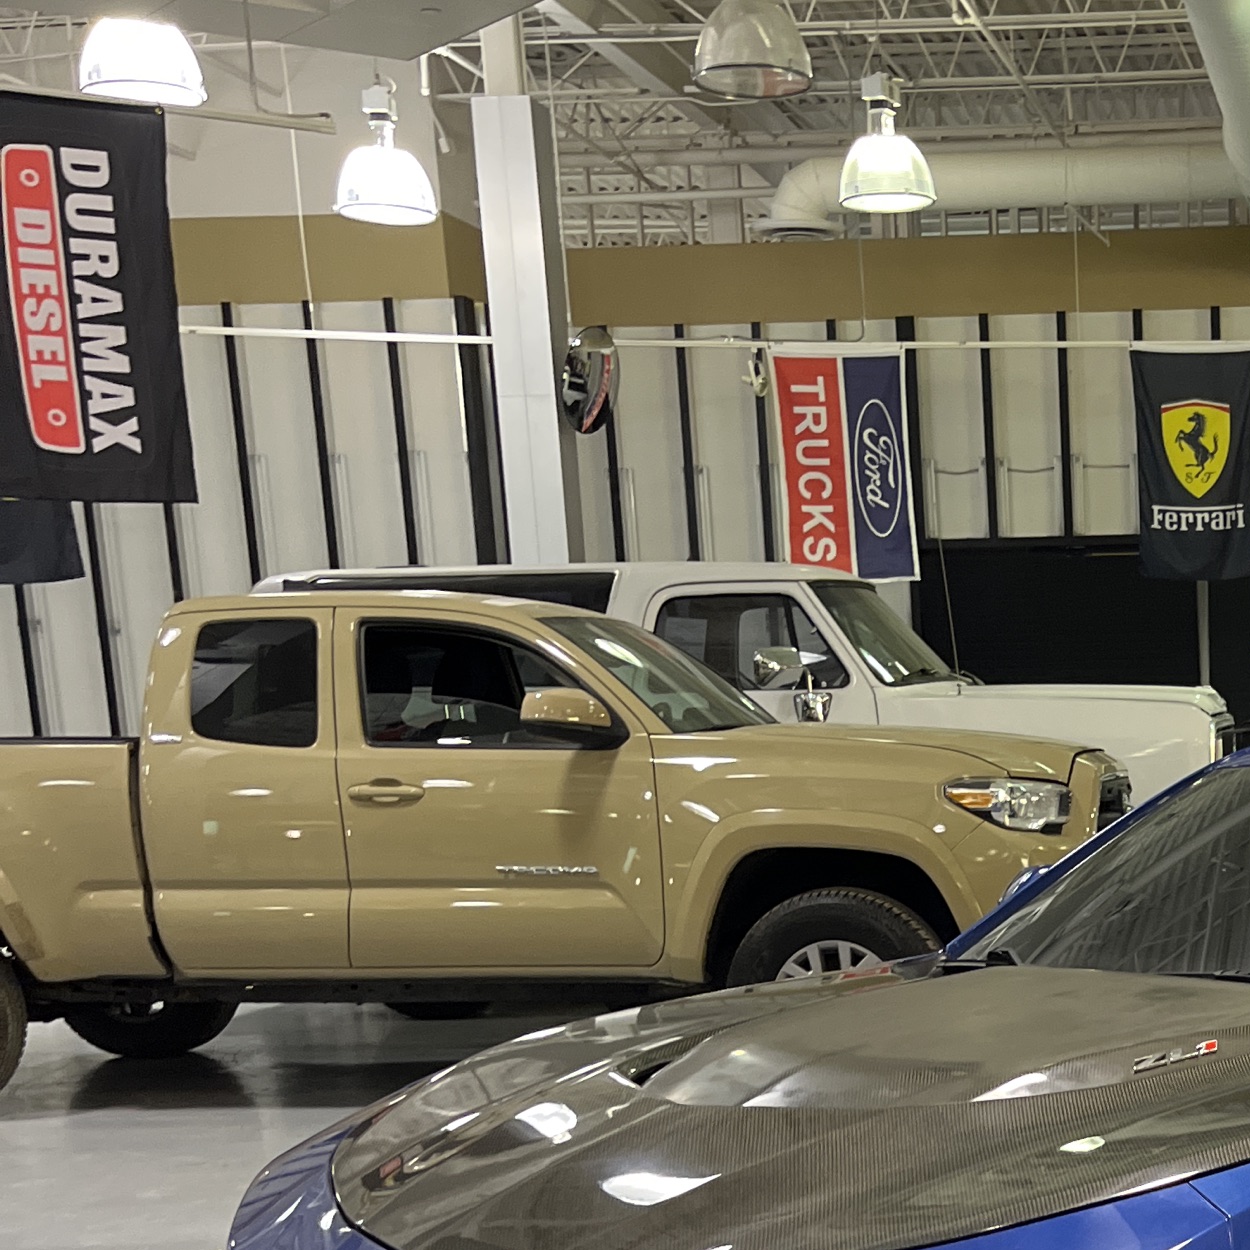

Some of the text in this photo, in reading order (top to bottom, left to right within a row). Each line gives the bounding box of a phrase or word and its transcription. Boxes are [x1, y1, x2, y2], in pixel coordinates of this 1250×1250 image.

[13, 206, 69, 388] DIESEL
[59, 146, 142, 454] DURAMAX
[790, 375, 837, 563] TRUCKS
[863, 427, 895, 508] Ford
[1151, 503, 1245, 531] Ferrari
[1132, 1039, 1218, 1074] ZL1
